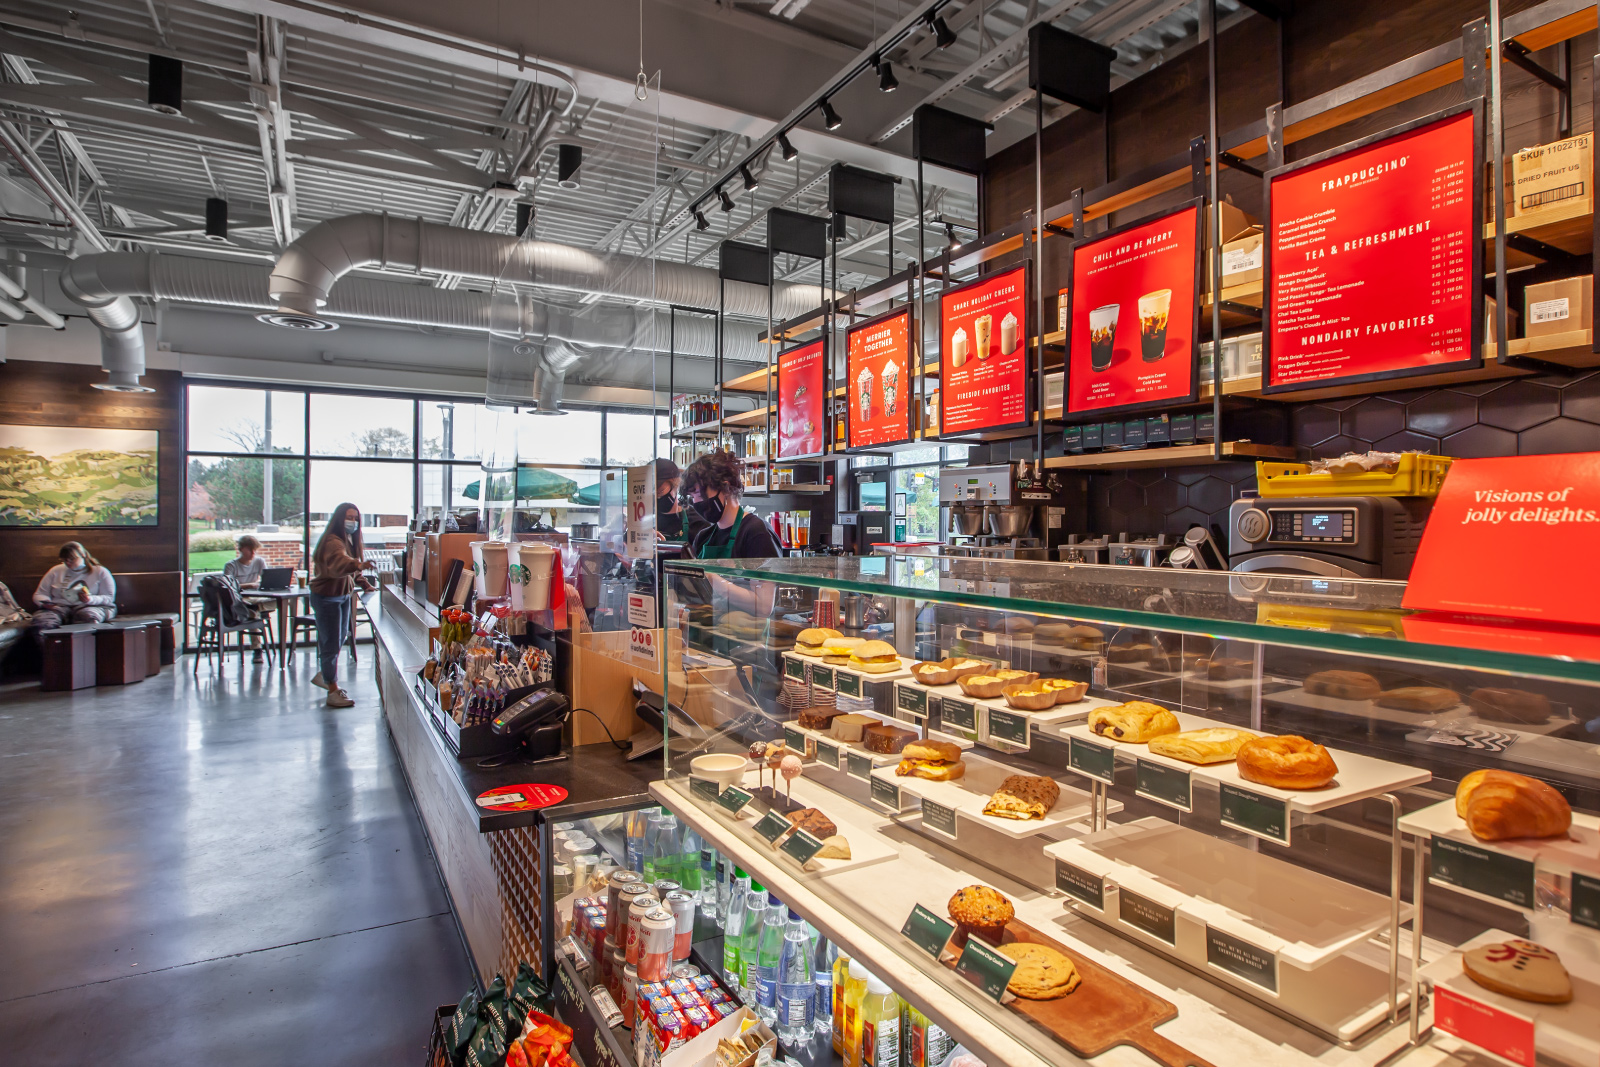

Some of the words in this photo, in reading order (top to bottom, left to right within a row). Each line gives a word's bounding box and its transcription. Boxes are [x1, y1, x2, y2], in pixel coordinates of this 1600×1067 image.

[1521, 149, 1544, 161] SKU#
[1518, 174, 1541, 184] DRIED
[1543, 168, 1566, 178] FRUIT
[1279, 227, 1299, 235] Caramel
[1300, 222, 1317, 230] Ribbon
[1318, 216, 1336, 225] Crunch
[1279, 233, 1307, 243] Peppermint
[1305, 249, 1324, 260] TEA
[1330, 245, 1337, 254] &
[1344, 220, 1430, 251] REFRESHMENT
[1093, 251, 1112, 263] CHILL
[1116, 245, 1130, 256] AND
[1134, 241, 1142, 250] BE
[1147, 231, 1172, 246] MERRY
[1279, 270, 1305, 279] Strawberry
[1337, 281, 1364, 290] Lemonade
[1316, 294, 1342, 303] Lemonade
[866, 329, 890, 343] MERRIER
[1302, 328, 1359, 346] NONDAIRY
[1367, 314, 1434, 335] FAVORITES
[864, 338, 892, 352] TOGETHER
[958, 390, 980, 400] FIRESIDE
[983, 384, 1010, 395] FAVORITES
[633, 485, 645, 494] GIVE
[1475, 489, 1544, 503] Visions
[1548, 487, 1574, 502] of
[633, 502, 645, 521] 10
[1461, 508, 1508, 524] jolly
[984, 952, 994, 961] Chip
